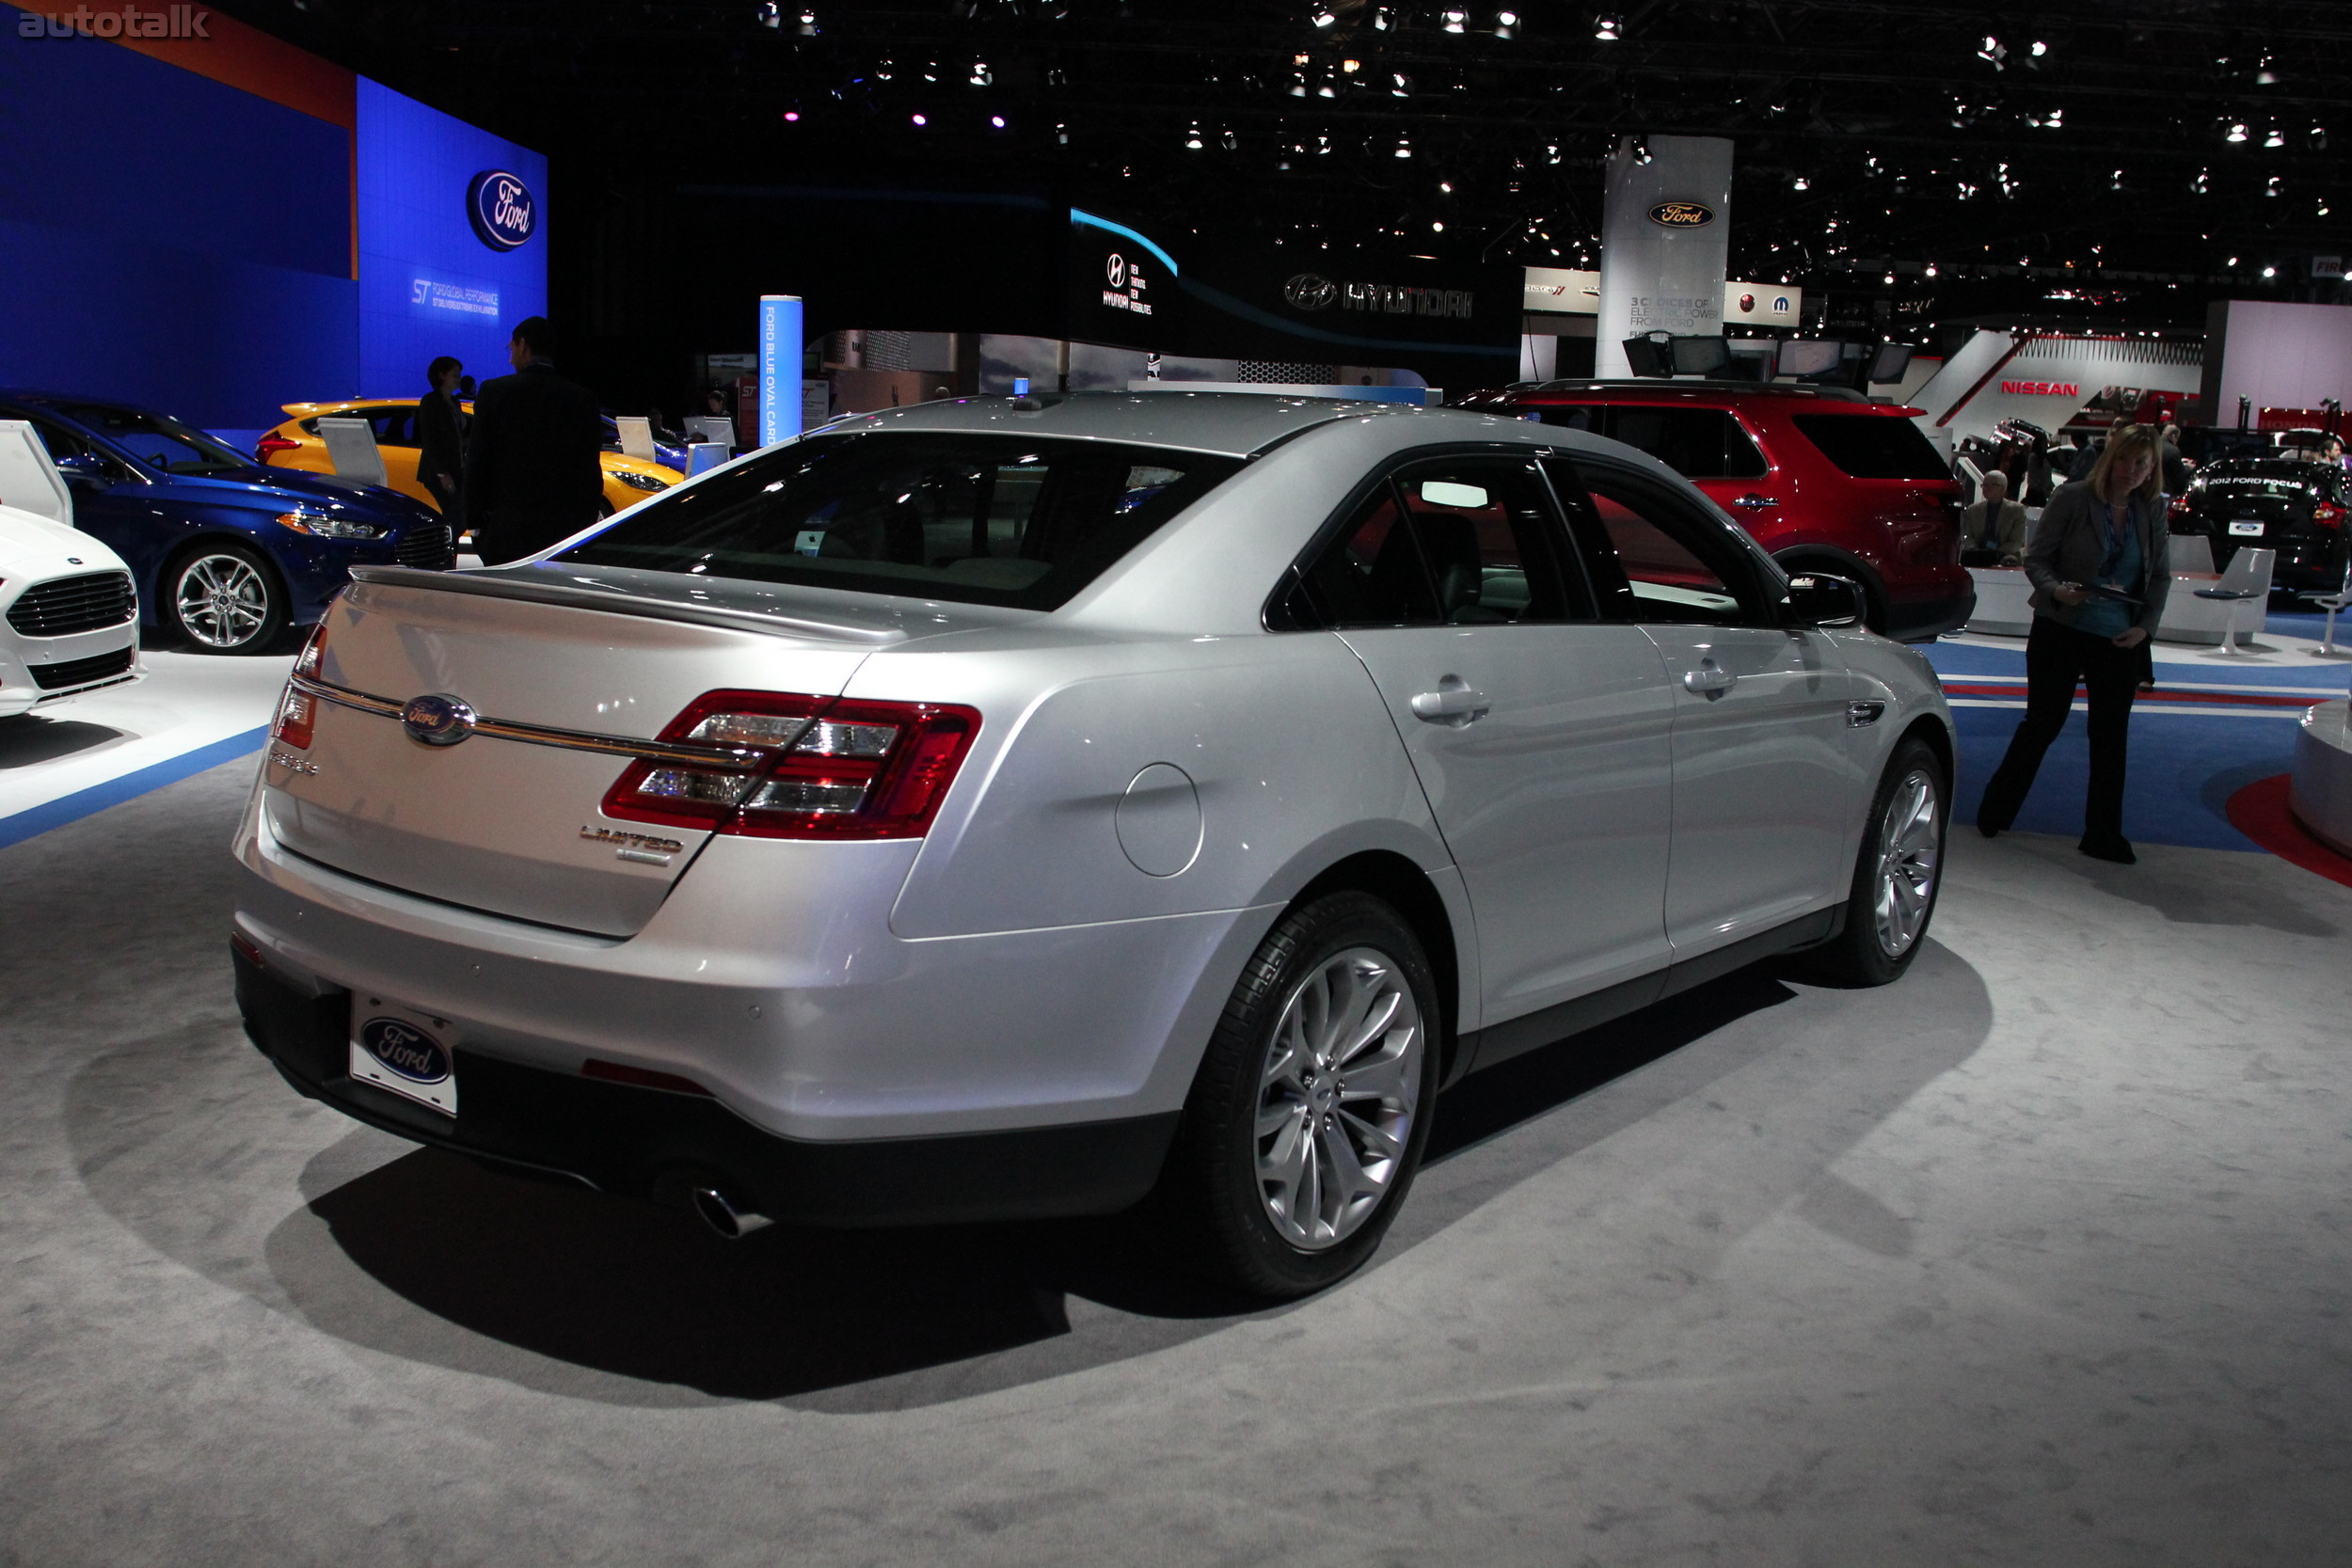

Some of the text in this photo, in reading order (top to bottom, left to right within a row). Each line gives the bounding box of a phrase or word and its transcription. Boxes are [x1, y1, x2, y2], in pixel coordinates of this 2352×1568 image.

[495, 180, 531, 234] Ford
[1661, 205, 1703, 223] Ford
[411, 278, 432, 305] ST
[1103, 290, 1129, 309] HYUNDAI
[1343, 281, 1474, 319] HYUNDAI
[1630, 297, 1638, 307] 3
[1694, 299, 1709, 309] OF
[1664, 317, 1694, 328] FORD
[1684, 309, 1719, 320] POWER
[766, 307, 777, 445] FORD BLUE OVAL CARD
[2001, 380, 2079, 396] NISSAN
[2263, 478, 2302, 489] FOCUS
[580, 826, 684, 853] LIMITED
[378, 1025, 432, 1074] Ford
